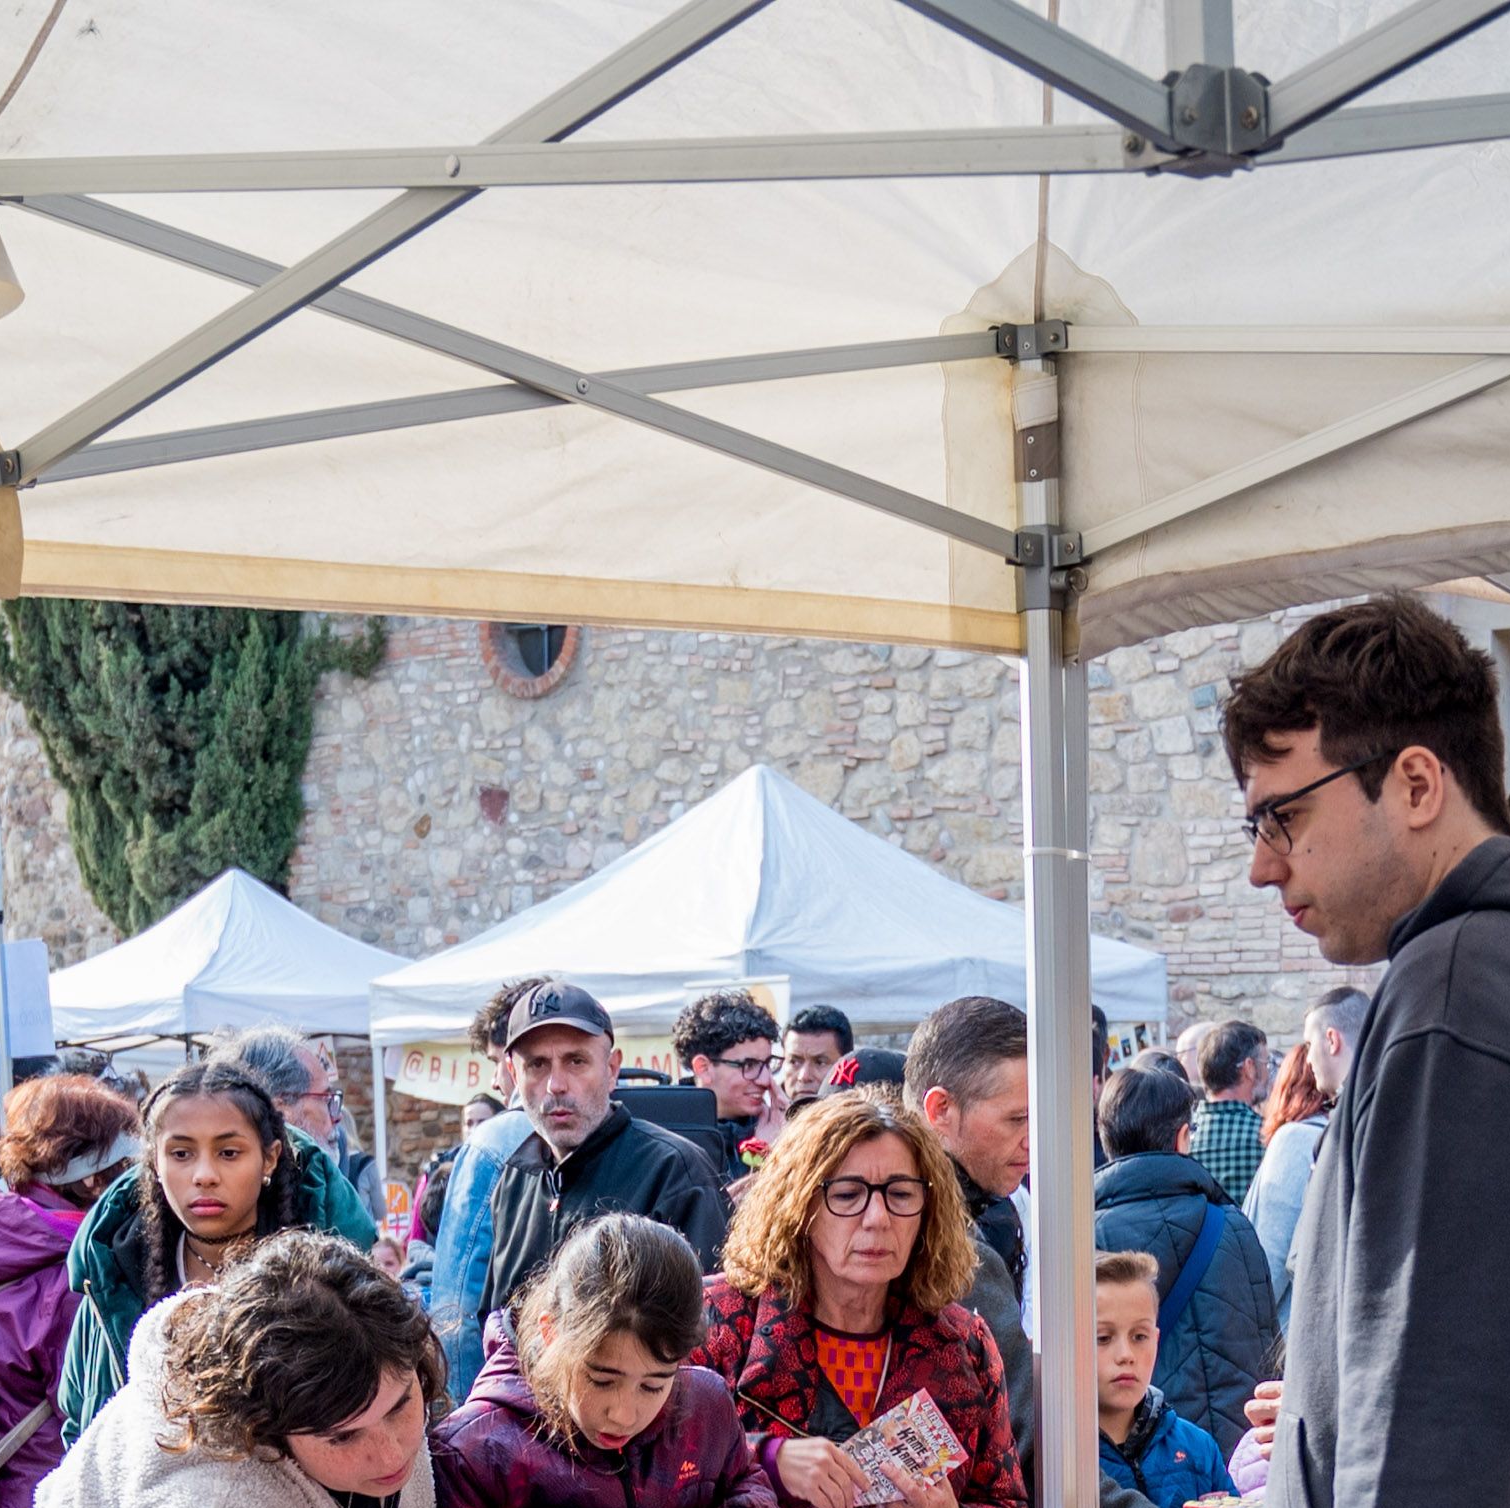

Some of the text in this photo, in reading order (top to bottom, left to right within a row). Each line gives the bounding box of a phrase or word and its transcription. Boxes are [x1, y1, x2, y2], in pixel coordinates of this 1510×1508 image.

[828, 1056, 859, 1085] NY
[897, 1427, 929, 1457] KAME
[890, 1443, 922, 1474] KAME
